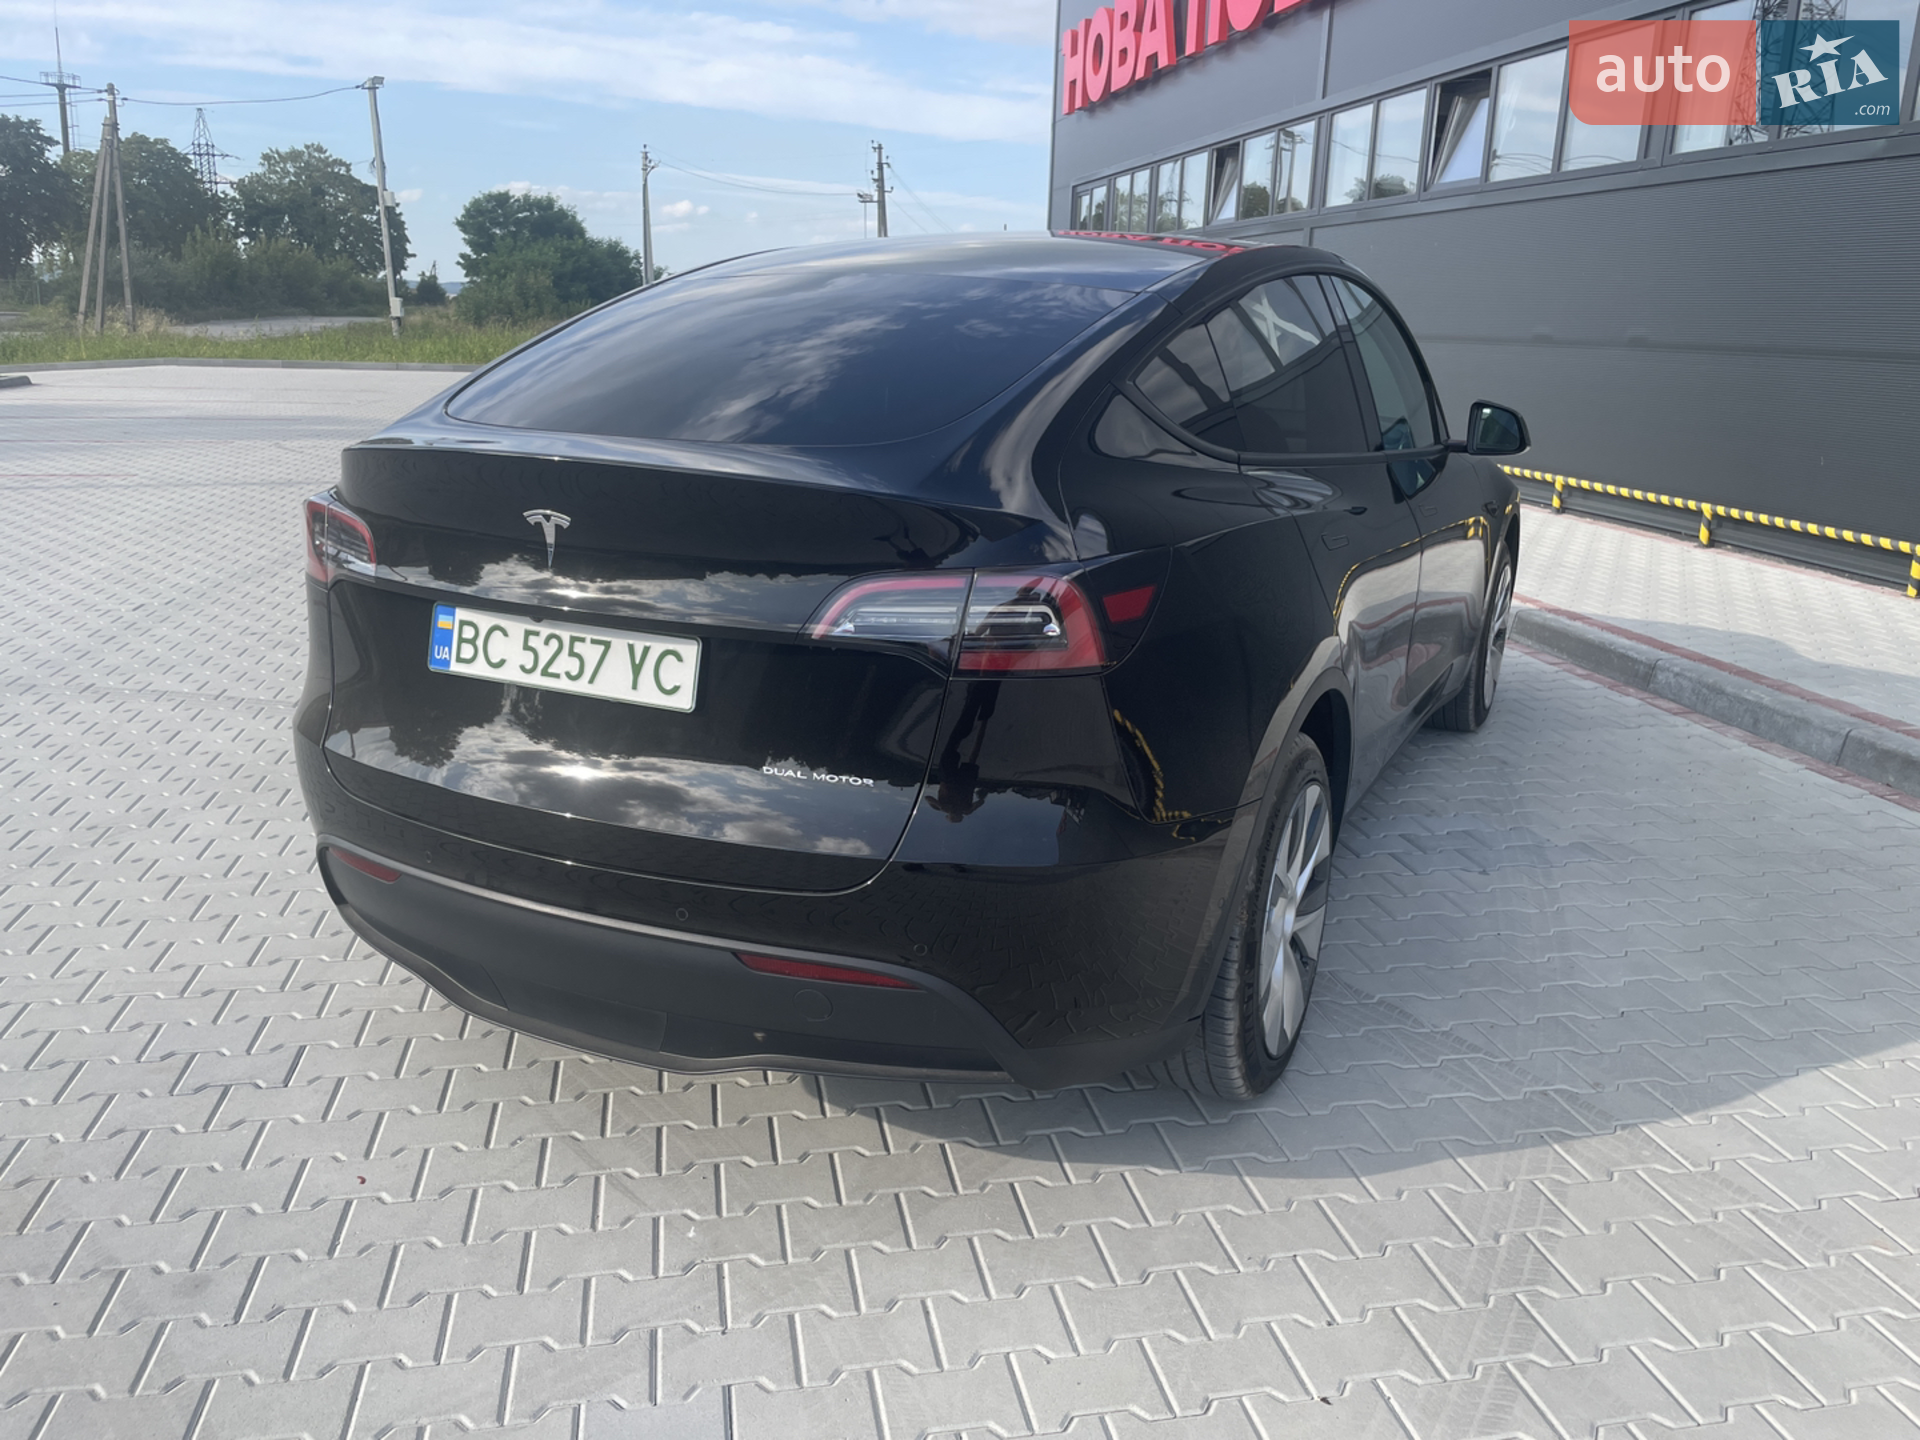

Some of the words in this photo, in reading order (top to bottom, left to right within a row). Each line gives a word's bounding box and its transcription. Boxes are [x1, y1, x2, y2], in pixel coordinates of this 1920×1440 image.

[1061, 0, 1177, 116] НОВА
[434, 645, 450, 661] UA
[454, 618, 509, 669] BC
[518, 628, 612, 685] 5257
[627, 641, 684, 696] YC
[762, 766, 807, 779] DUAL
[812, 772, 874, 787] MOTOR
